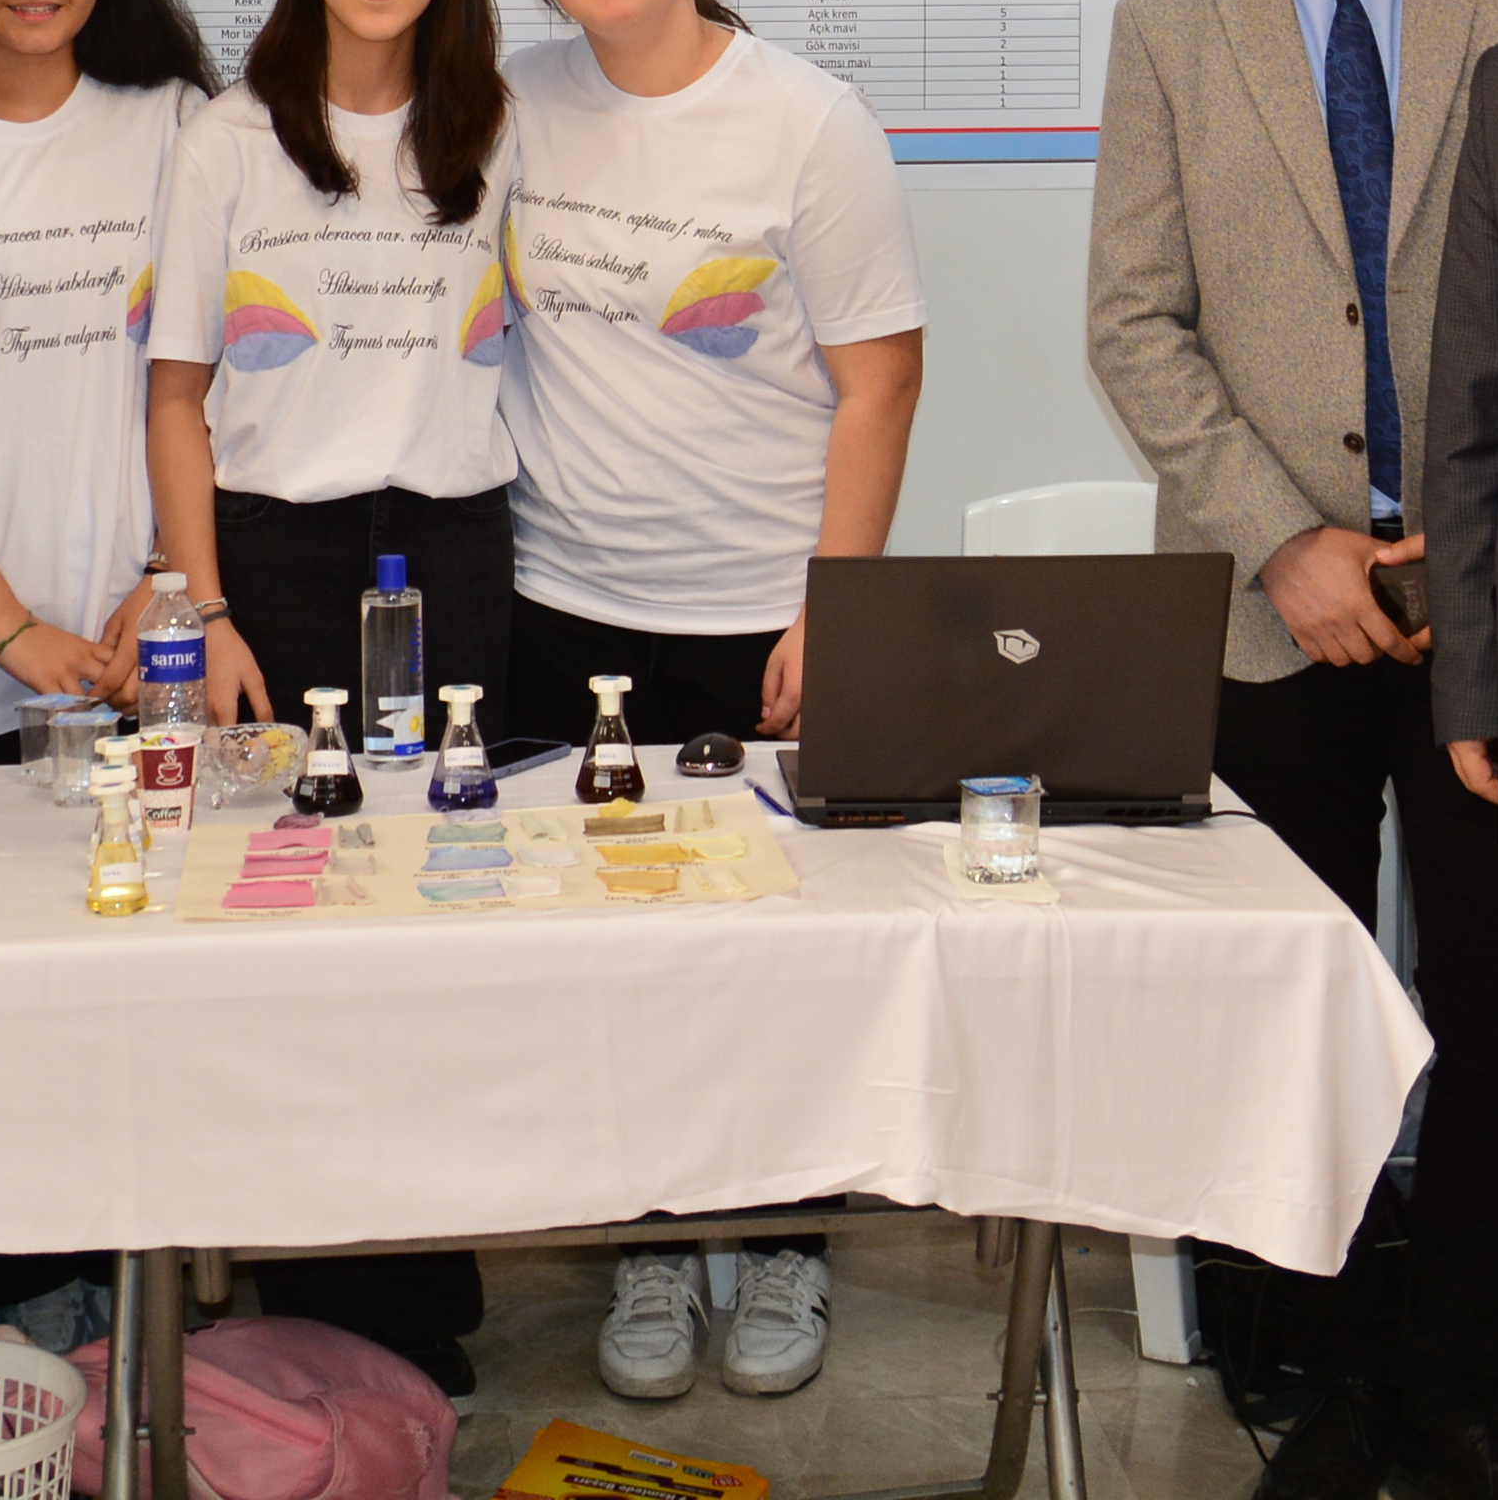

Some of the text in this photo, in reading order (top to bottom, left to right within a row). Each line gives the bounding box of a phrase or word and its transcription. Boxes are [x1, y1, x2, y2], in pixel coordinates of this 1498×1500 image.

[45, 228, 74, 240] var.
[80, 219, 135, 243] capitata
[133, 216, 146, 241] f.
[239, 225, 474, 254] Brassica oleracea var. capitata f.
[55, 265, 126, 296] sabdariffa
[1, 325, 117, 363] Thymus vulgaris
[151, 651, 197, 667] sarnıç
[145, 808, 182, 821] Coffee
